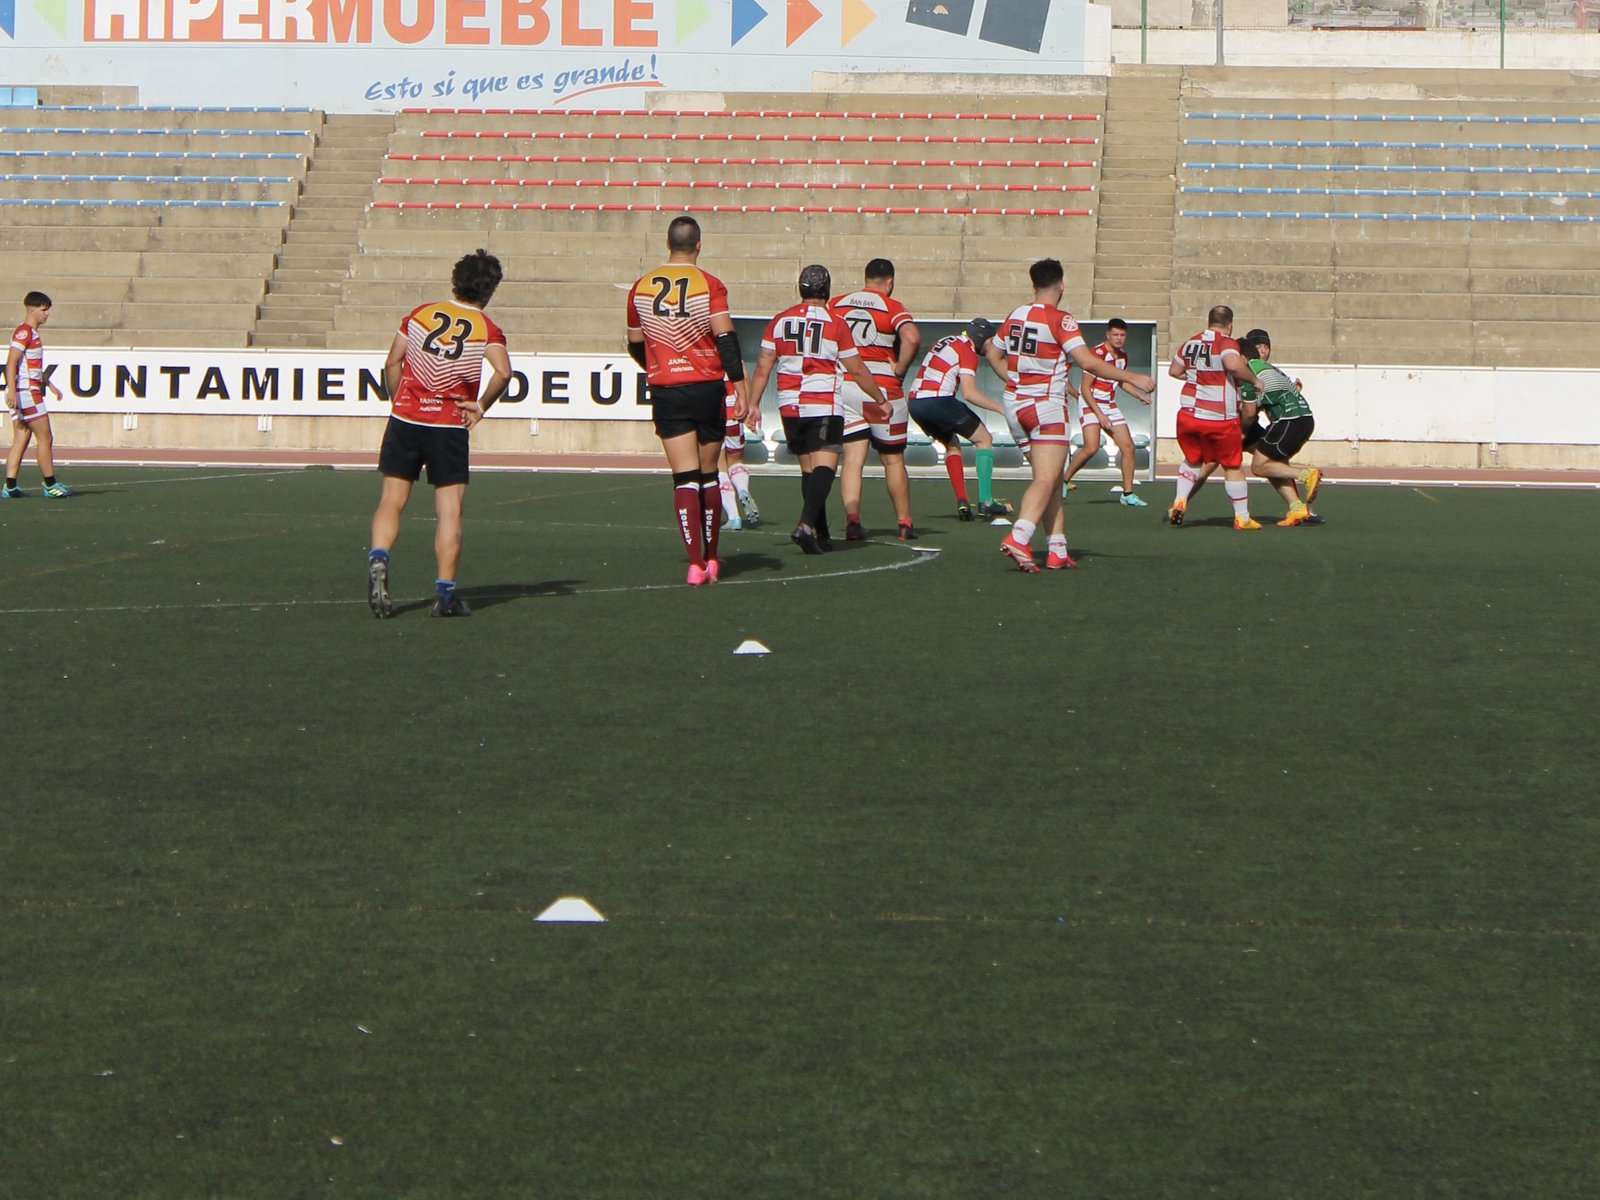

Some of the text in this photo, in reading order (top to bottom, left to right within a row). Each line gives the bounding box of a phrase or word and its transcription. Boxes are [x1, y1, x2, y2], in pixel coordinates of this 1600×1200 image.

[365, 53, 659, 102] Esto si que es grande!
[651, 276, 691, 318] 21
[421, 311, 472, 361] 23
[783, 320, 823, 355] 41
[845, 317, 872, 339] 77
[1185, 342, 1212, 368] 44
[499, 370, 570, 404] DE
[679, 508, 692, 545] MORLEY
[705, 509, 714, 544] MORLEY
